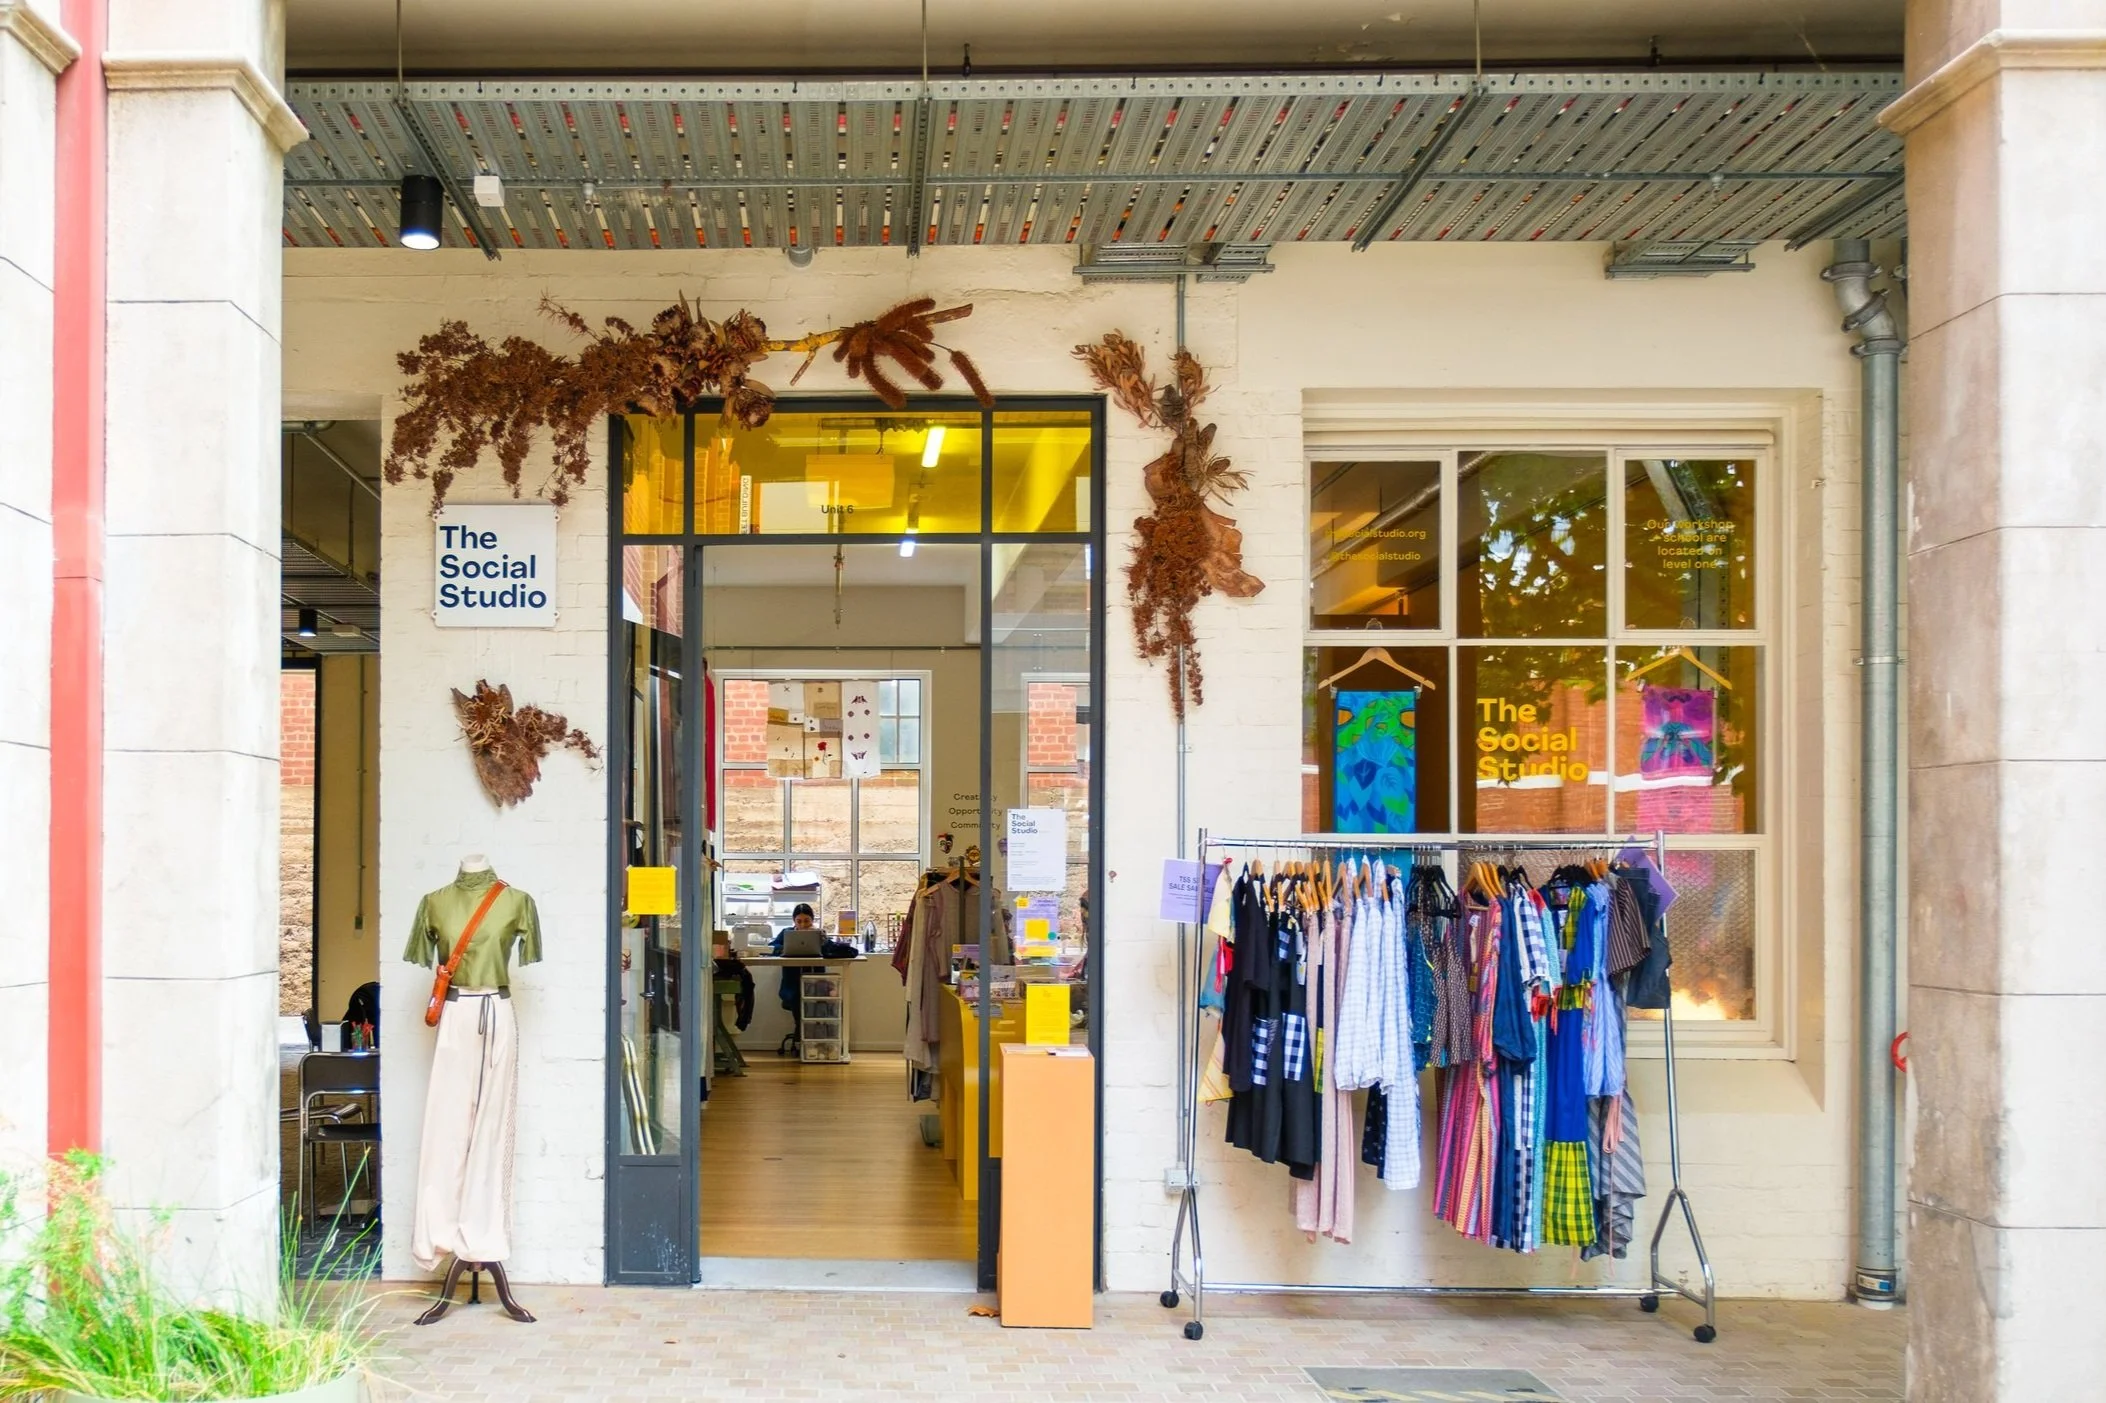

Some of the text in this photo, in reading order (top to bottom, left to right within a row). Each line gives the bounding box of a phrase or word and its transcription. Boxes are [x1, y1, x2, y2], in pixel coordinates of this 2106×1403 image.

[821, 505, 854, 514] Unit 6
[439, 525, 497, 549] The
[1663, 534, 1703, 542] school
[1658, 546, 1704, 555] located
[440, 554, 536, 578] Social
[1663, 559, 1691, 568] level
[439, 584, 547, 608] Studio
[1477, 698, 1536, 722] The
[1477, 727, 1576, 751] Social
[1479, 756, 1588, 781] Studio
[953, 793, 998, 801] Creaty
[950, 821, 1000, 830] Commty
[1169, 883, 1185, 891] SALE
